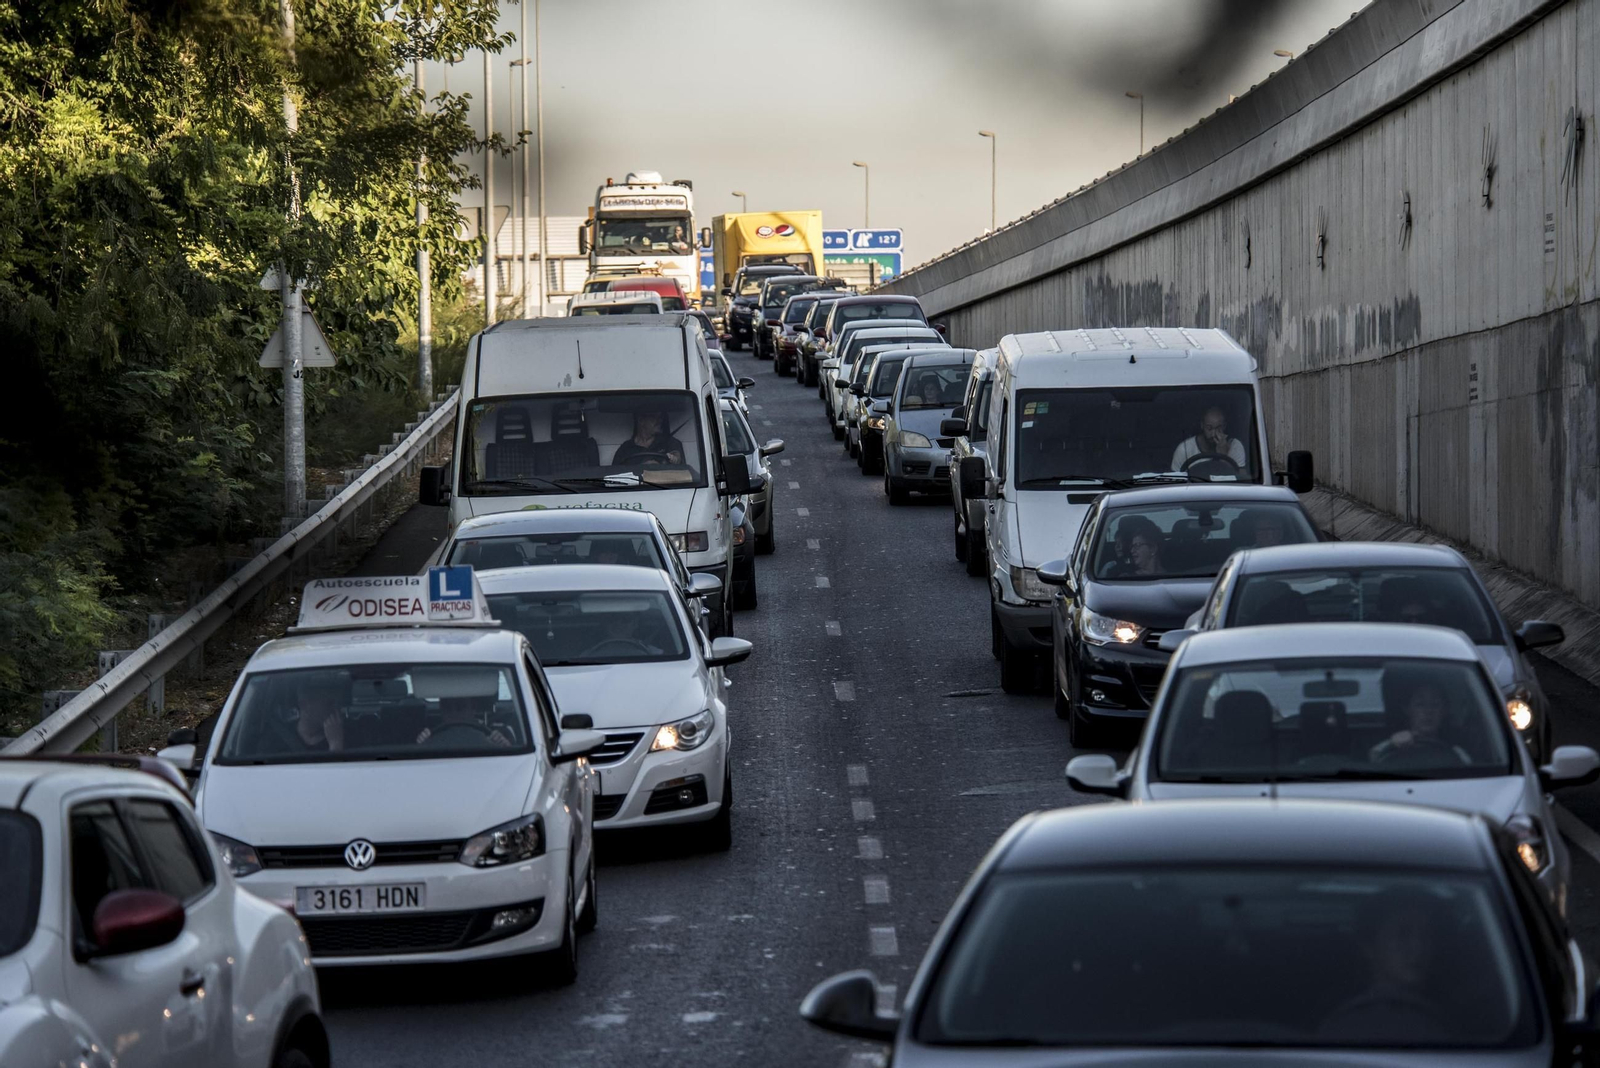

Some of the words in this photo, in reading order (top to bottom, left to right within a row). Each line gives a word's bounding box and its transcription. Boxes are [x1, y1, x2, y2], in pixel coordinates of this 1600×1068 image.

[823, 235, 832, 245] 0
[878, 235, 897, 244] 127
[313, 577, 421, 589] Autoescuela
[439, 572, 461, 597] L
[348, 597, 425, 618] ODISEA
[314, 888, 363, 910] 3161
[376, 886, 419, 908] HDN
